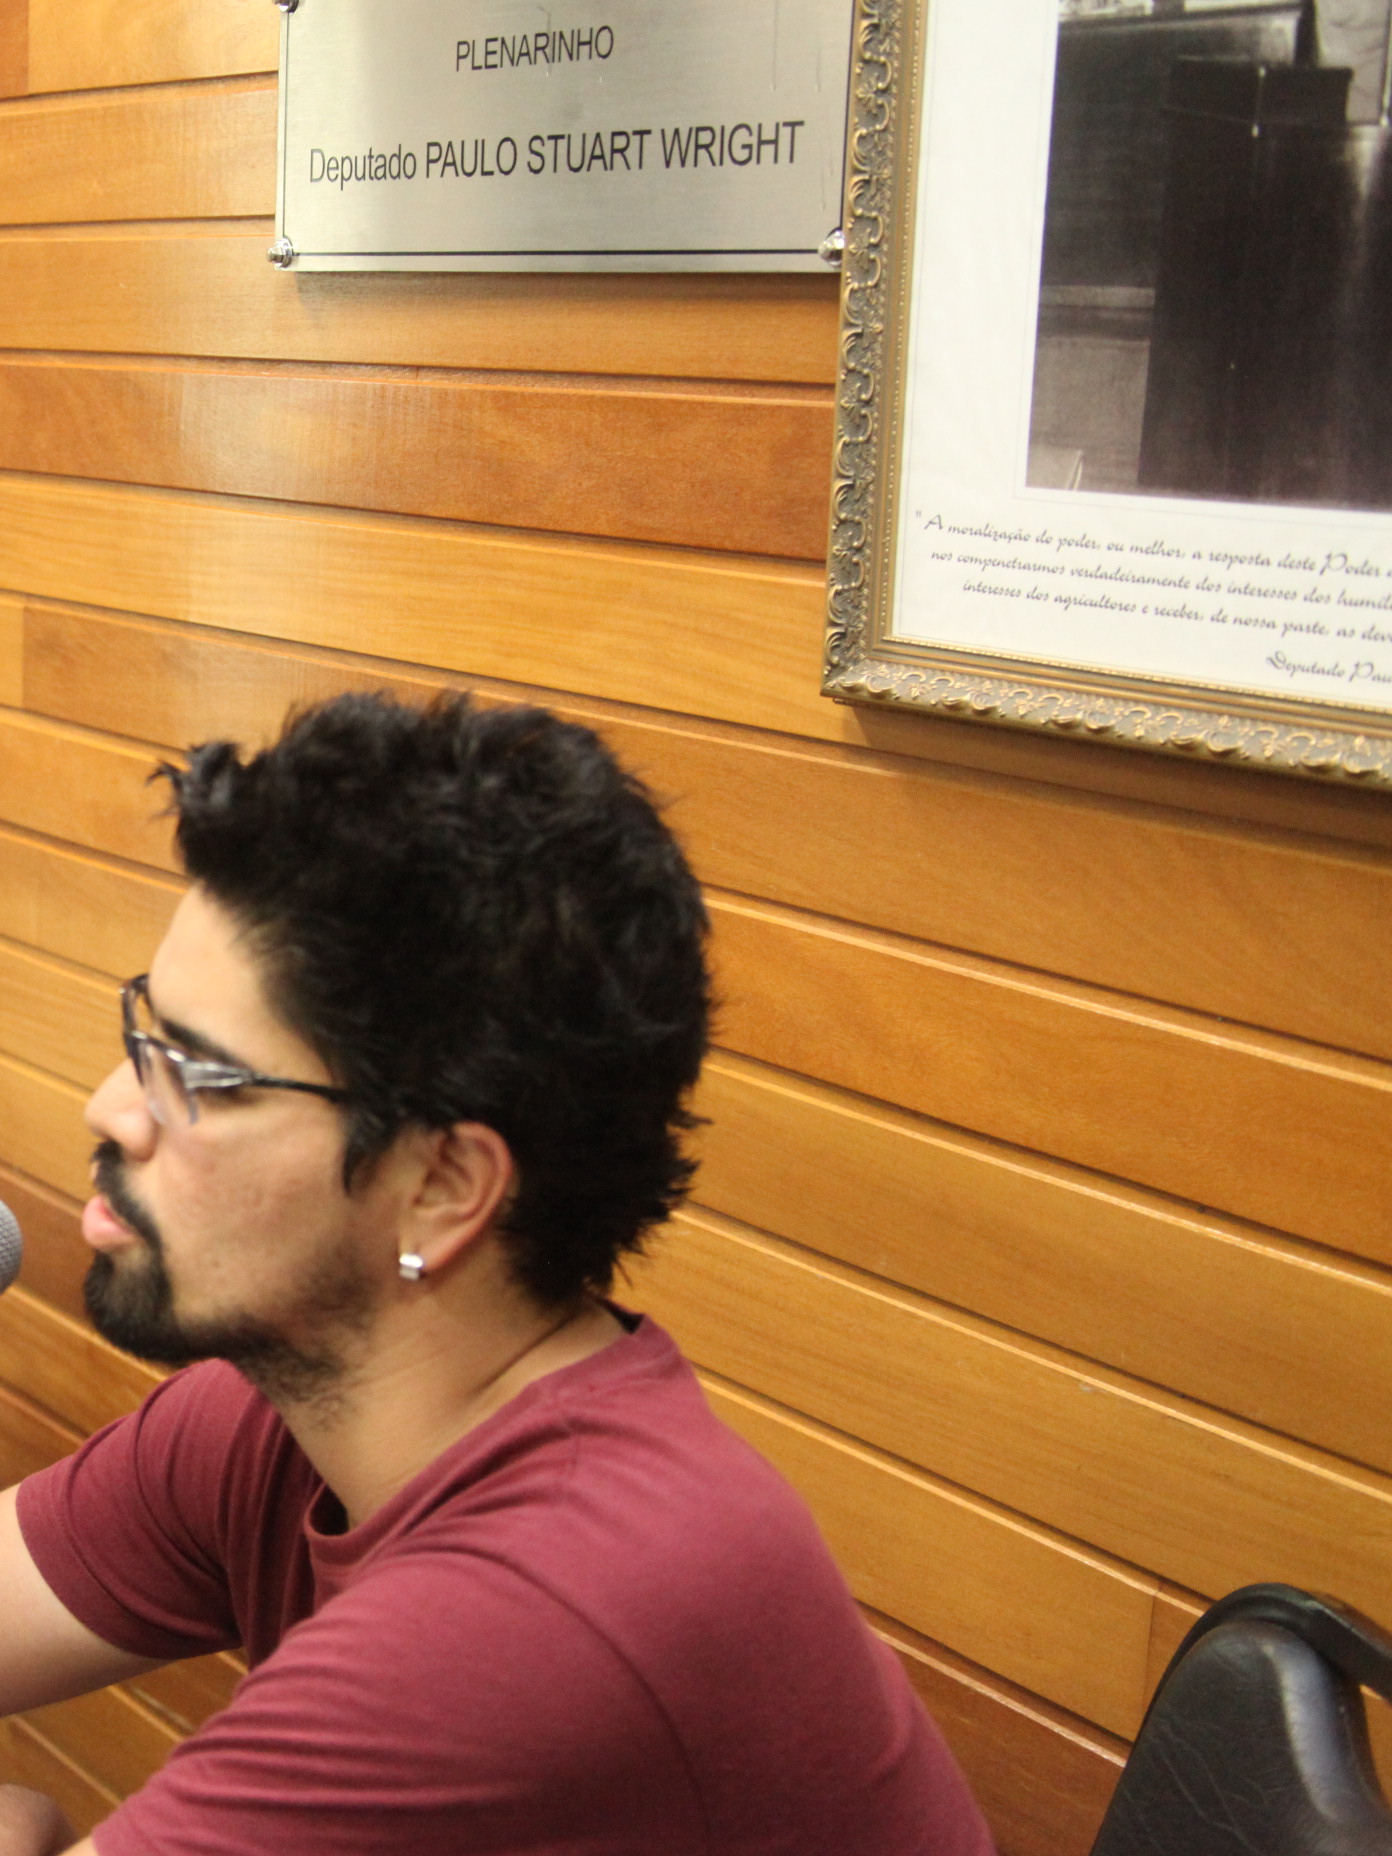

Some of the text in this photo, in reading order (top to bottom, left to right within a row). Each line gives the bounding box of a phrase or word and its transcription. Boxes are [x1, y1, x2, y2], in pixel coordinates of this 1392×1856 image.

[455, 23, 616, 72] PLENARINHO
[309, 120, 805, 191] Deputado PAULO STUART WRIGHT
[948, 522, 1032, 544] moralização
[1035, 529, 1053, 545] do
[1106, 541, 1124, 552] ou
[1192, 550, 1203, 560] a
[1209, 552, 1271, 571] resposta
[1277, 552, 1316, 571] deste
[1319, 551, 1380, 577] Poder
[931, 551, 953, 561] nos
[958, 556, 1066, 573] compenetrarmos
[1070, 564, 1191, 590] verdadeiramente
[1196, 576, 1221, 593] dos
[1227, 581, 1298, 601] interesses
[1303, 586, 1331, 604] dos
[963, 579, 1022, 598] interesses
[1026, 585, 1049, 602] dos
[1054, 594, 1137, 611] agricultores
[1141, 604, 1149, 614] e
[1210, 607, 1229, 624] de
[1233, 615, 1277, 629] nossa
[1336, 627, 1356, 638] as
[1265, 650, 1346, 678] Deputado
